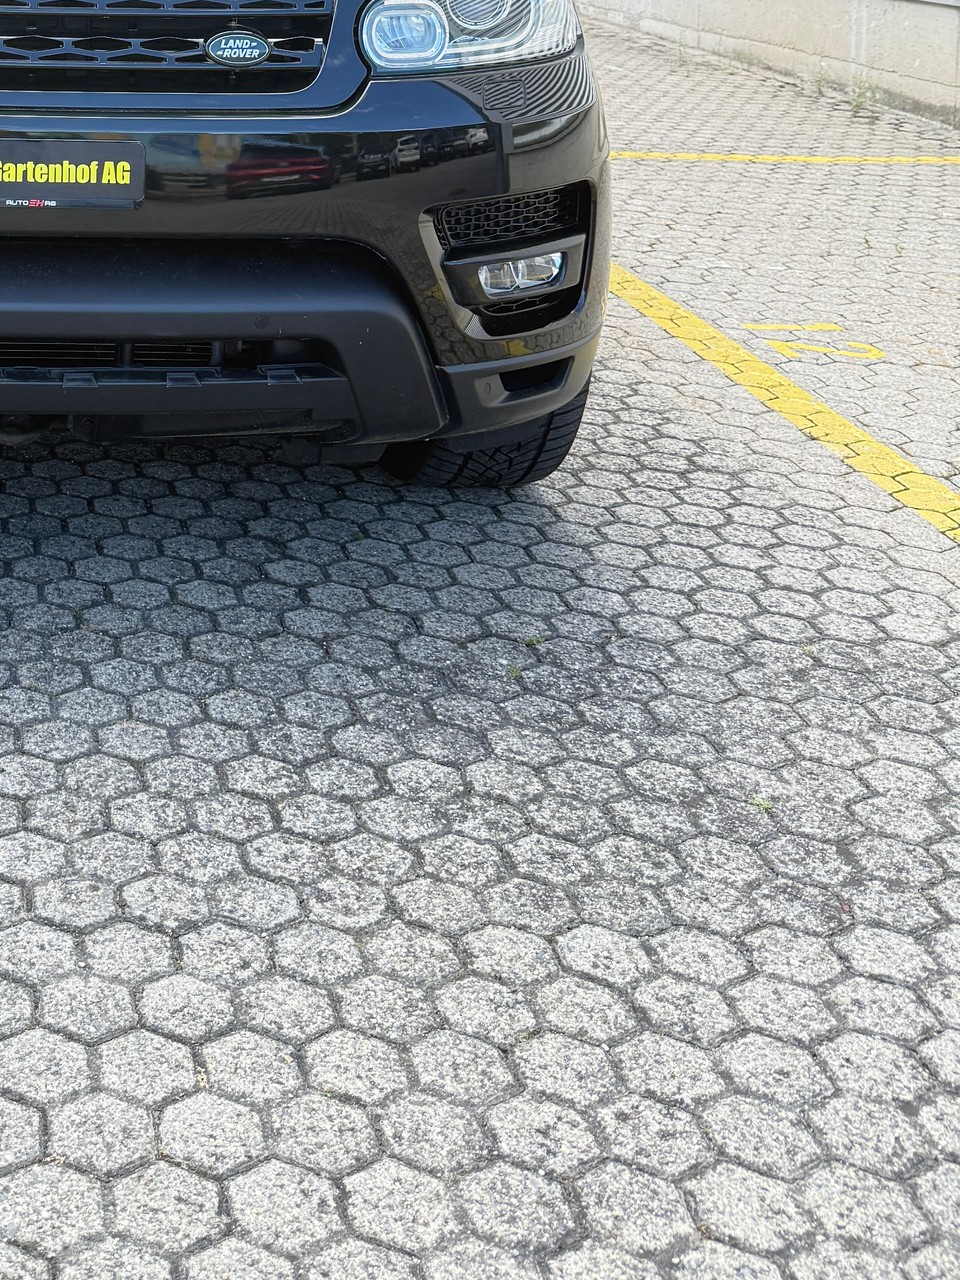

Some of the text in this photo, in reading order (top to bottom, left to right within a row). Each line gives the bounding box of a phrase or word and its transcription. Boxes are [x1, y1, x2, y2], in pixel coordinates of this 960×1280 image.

[220, 39, 251, 49] LAND
[222, 48, 260, 58] ROVER
[101, 161, 131, 185] AG
